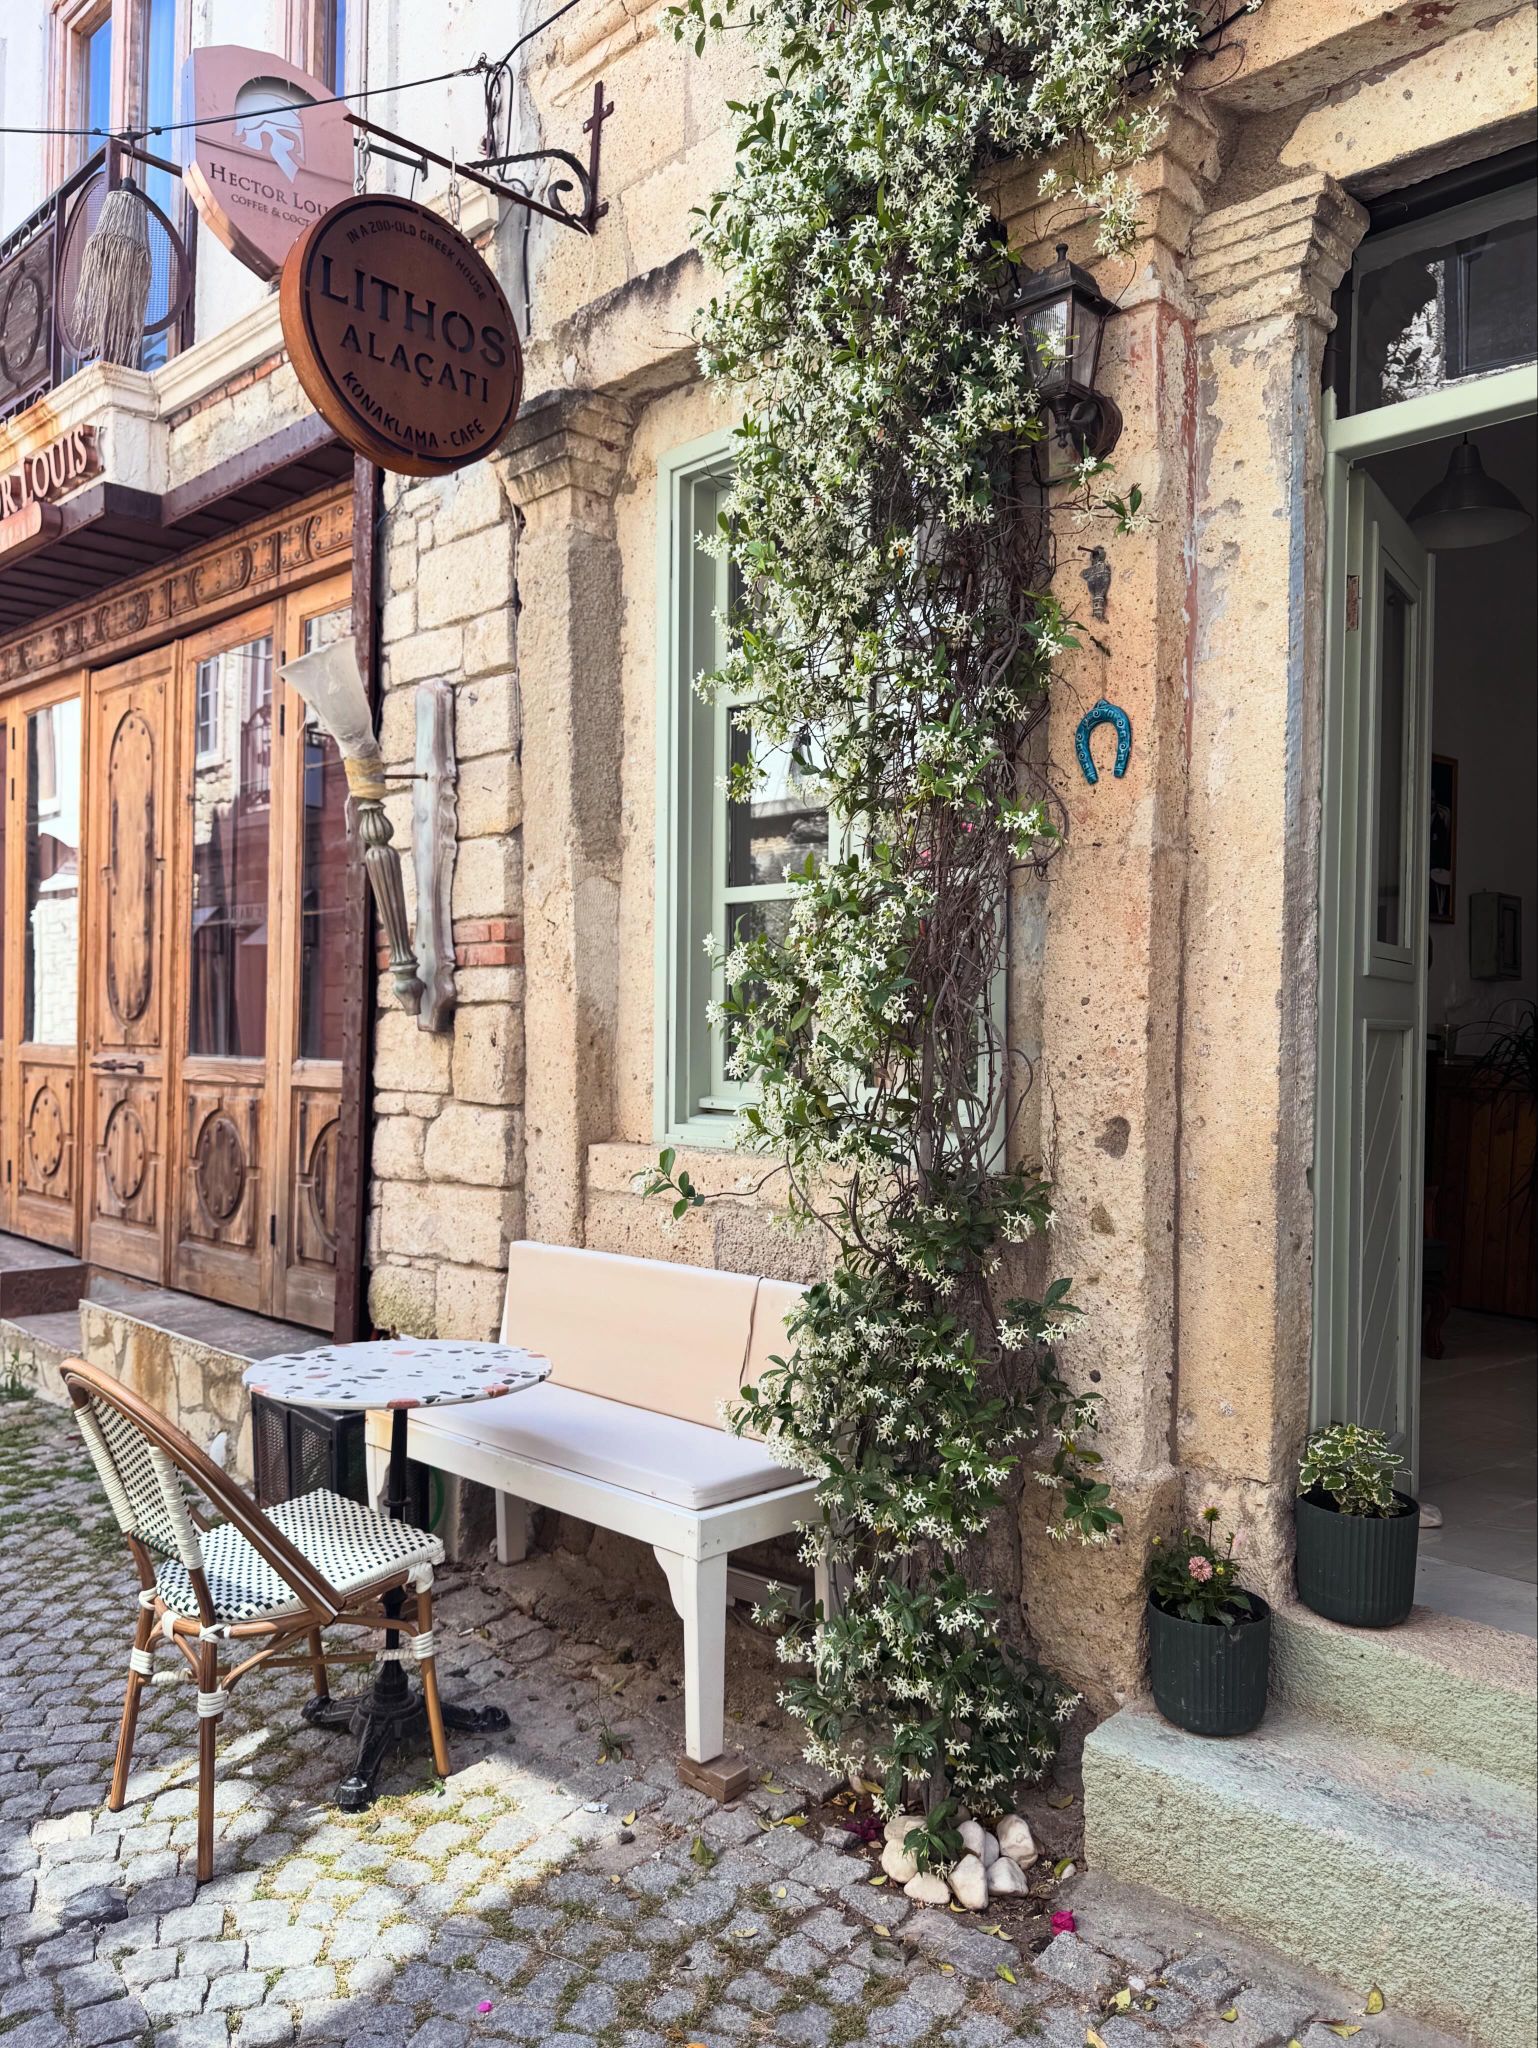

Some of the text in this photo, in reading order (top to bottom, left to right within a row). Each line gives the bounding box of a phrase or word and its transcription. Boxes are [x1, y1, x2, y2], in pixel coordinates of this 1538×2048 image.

[209, 162, 288, 205] HECTOR
[231, 193, 269, 214] COFFEE
[271, 206, 281, 218] &
[346, 220, 487, 301] IN A 200-OLD GREEK HOUSE
[320, 254, 506, 369] LITHOS
[340, 324, 489, 403] ALAÇATI
[342, 371, 486, 448] KONAKLAMA CAFE
[18, 423, 87, 509] LOUIS
